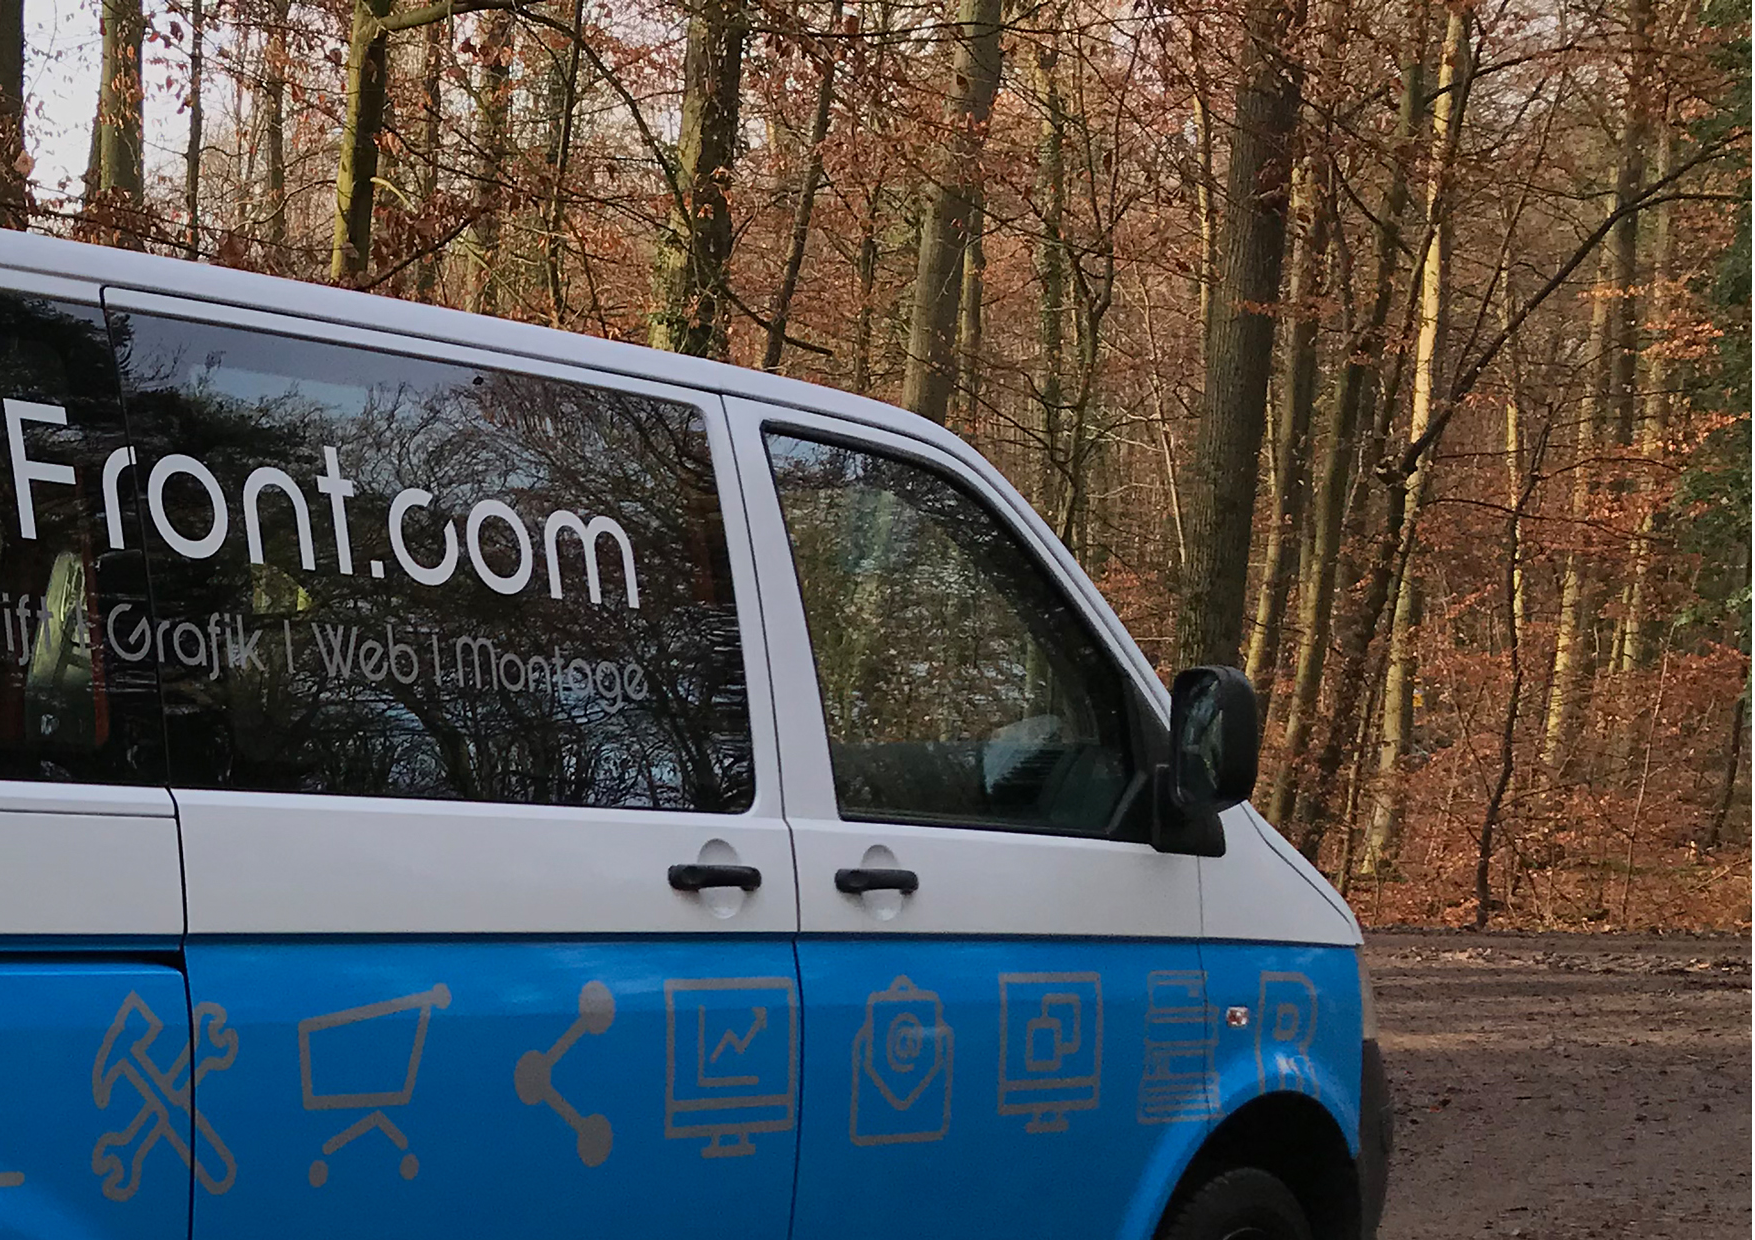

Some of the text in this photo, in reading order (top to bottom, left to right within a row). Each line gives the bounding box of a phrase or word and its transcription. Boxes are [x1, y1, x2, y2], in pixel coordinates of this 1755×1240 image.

[107, 603, 265, 681] Grafik
[311, 620, 419, 685] Web
[455, 637, 647, 713] Montage
